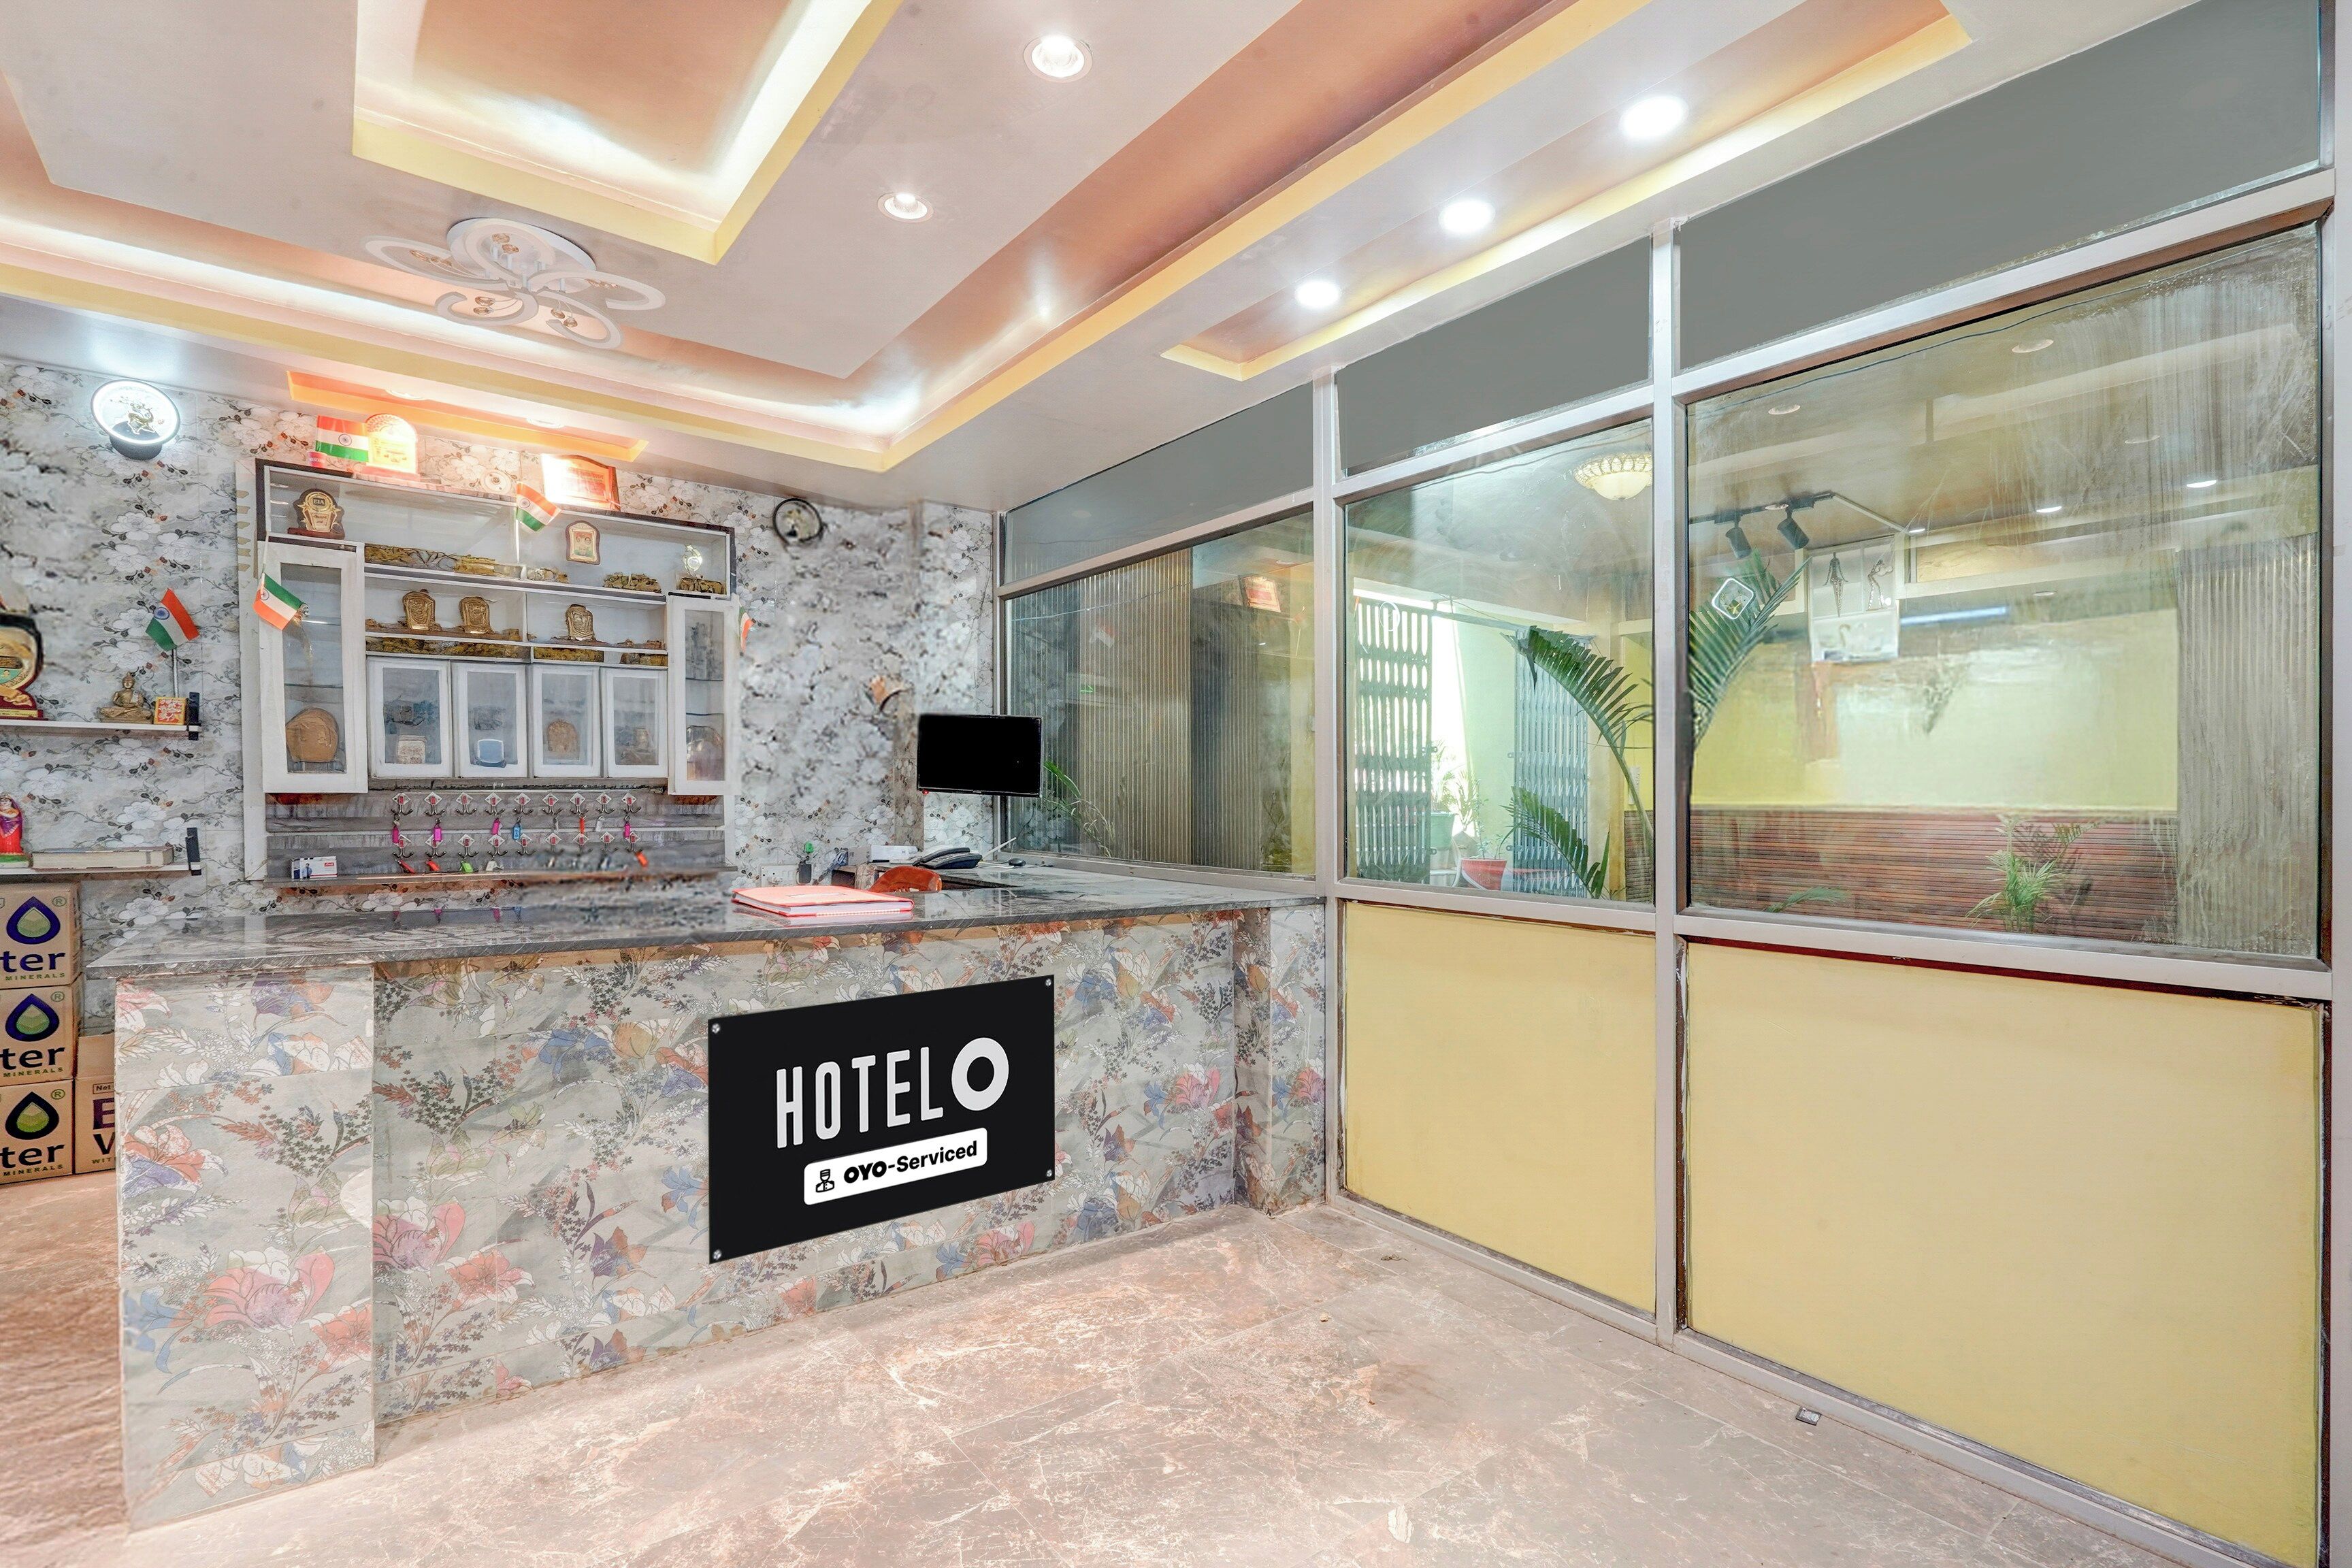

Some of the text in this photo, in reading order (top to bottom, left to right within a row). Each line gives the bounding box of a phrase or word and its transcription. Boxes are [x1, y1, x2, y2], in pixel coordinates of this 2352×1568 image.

[5, 973, 65, 981] MINERALS
[3, 1067, 63, 1077] MINERALS
[776, 1047, 944, 1149] HOTEL
[843, 1140, 977, 1183] OYO-Serviced
[3, 1164, 63, 1176] MINERALS
